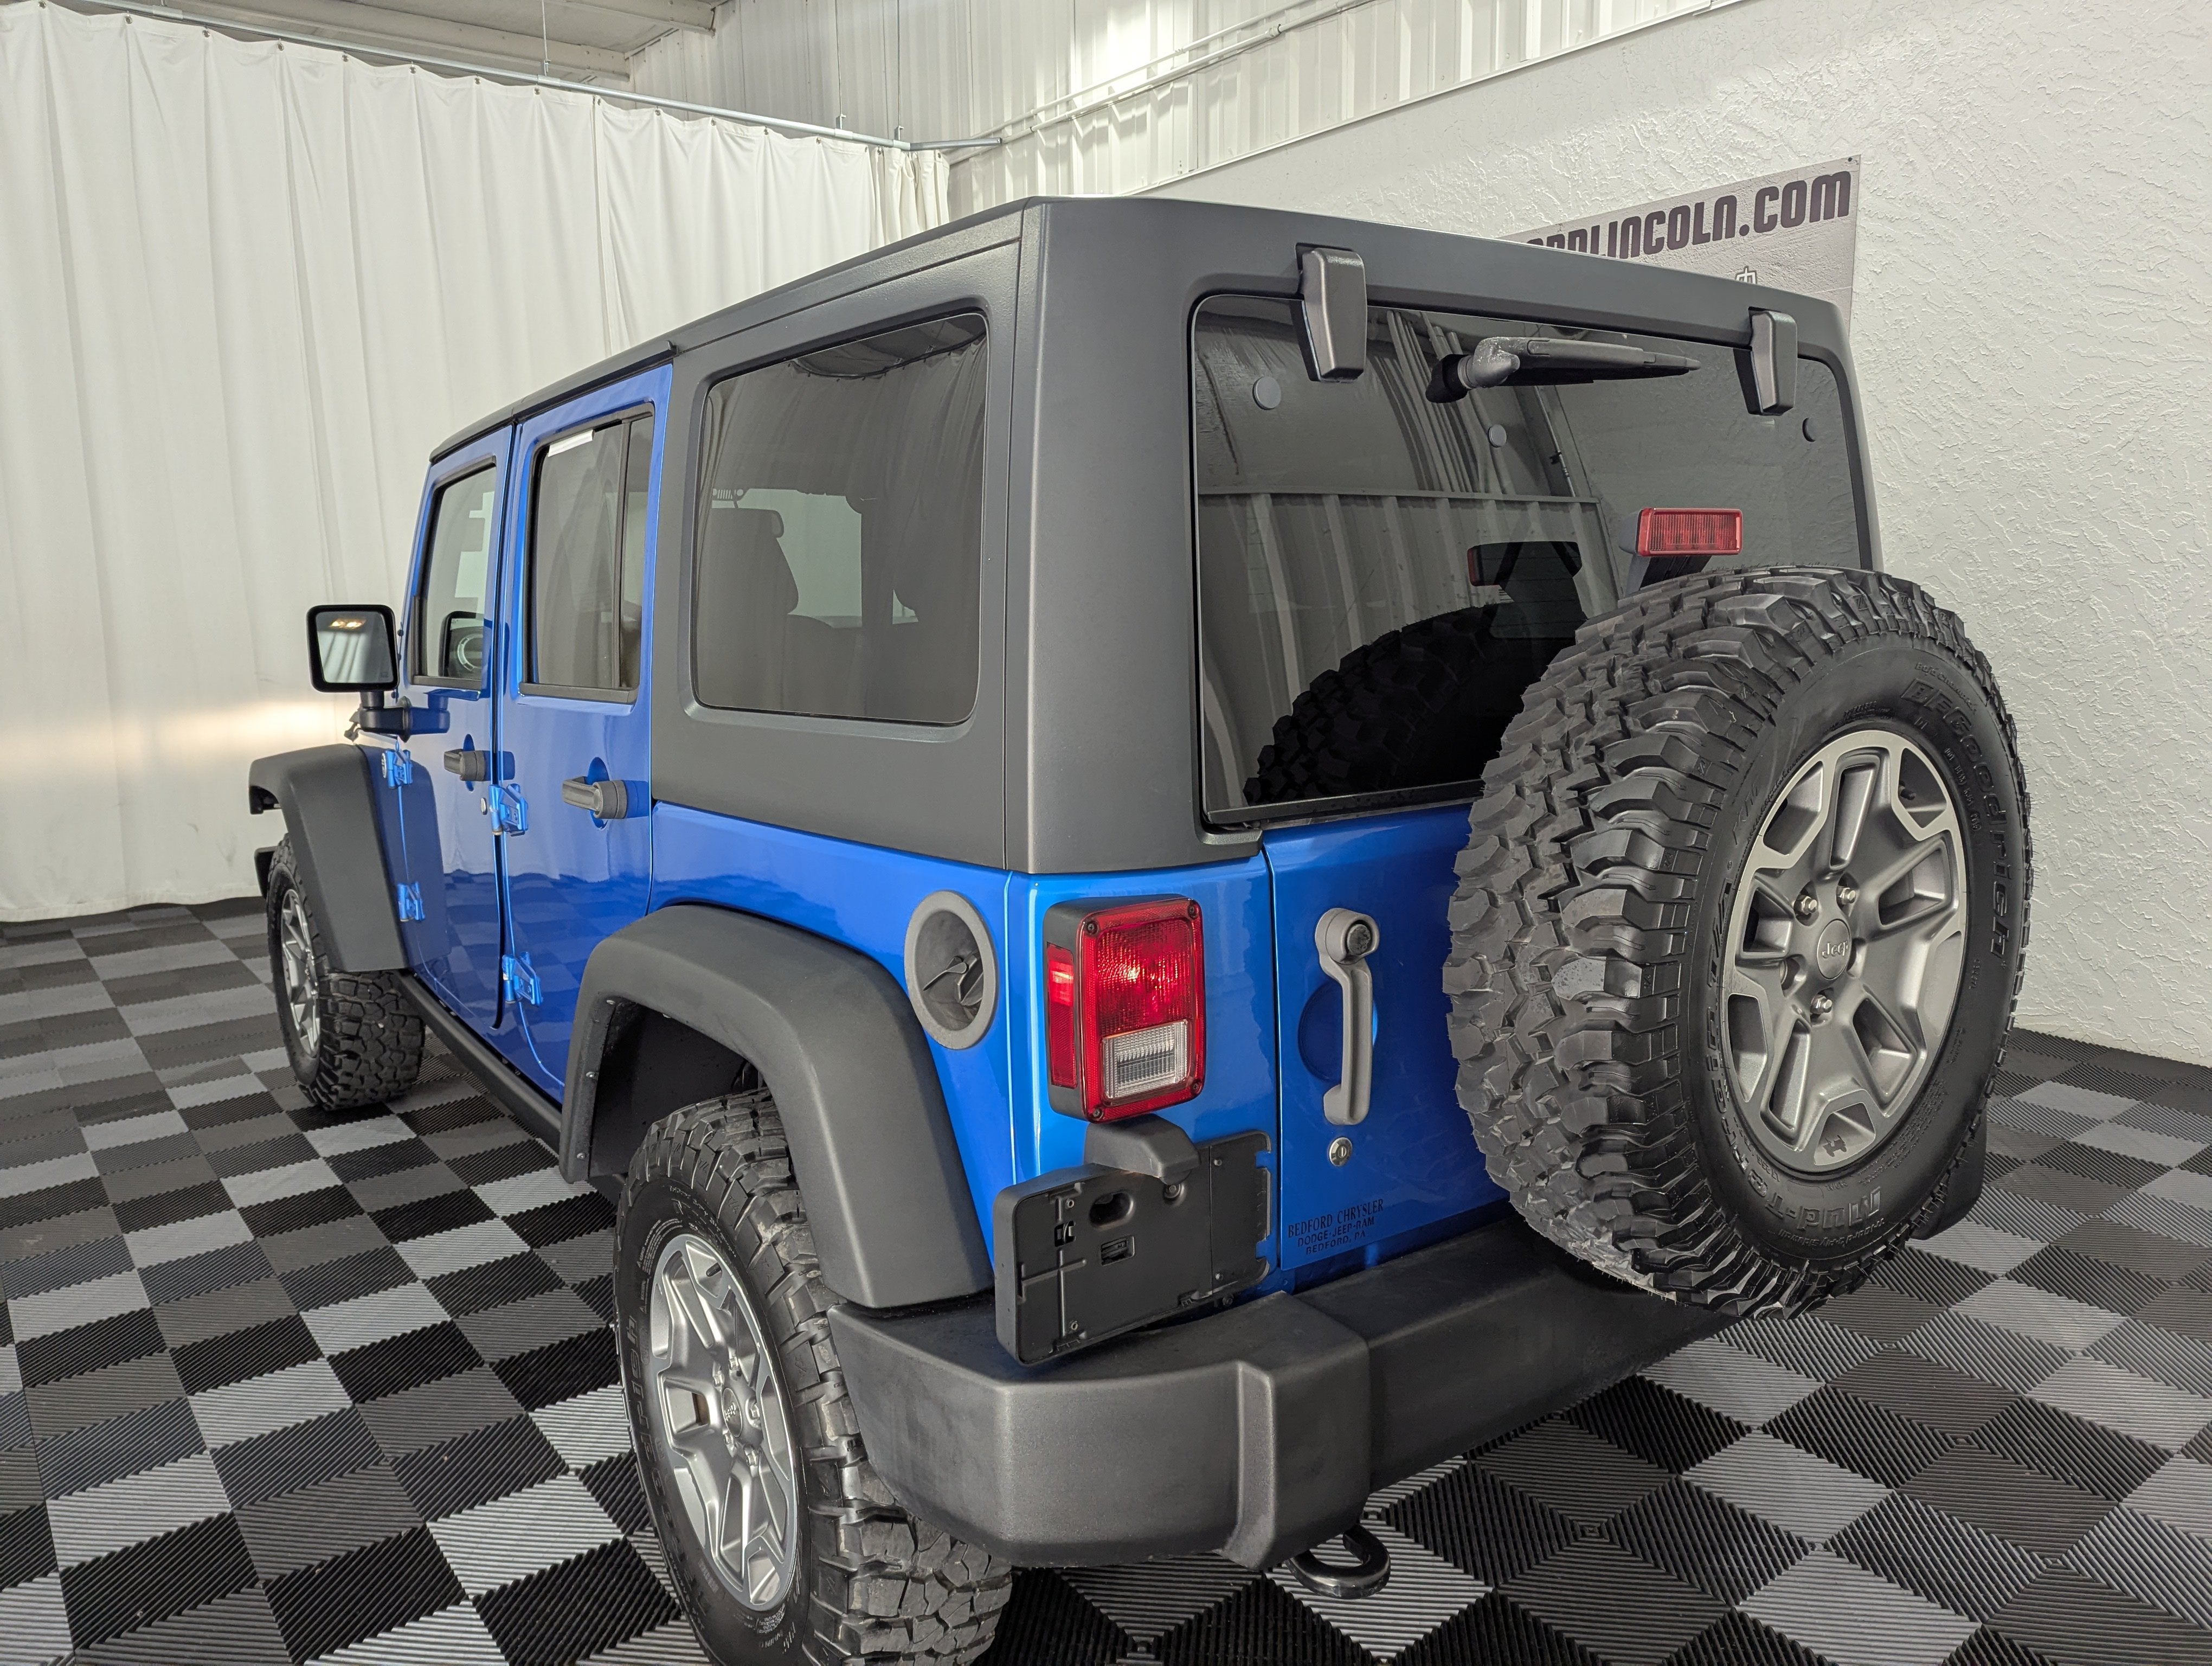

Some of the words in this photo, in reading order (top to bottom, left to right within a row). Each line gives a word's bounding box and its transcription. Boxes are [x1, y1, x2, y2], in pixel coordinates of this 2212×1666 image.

[1900, 678, 2012, 959] BFGoodrich
[1822, 941, 1848, 959] Jeep
[1288, 1214, 1333, 1238] BEDFORD
[1337, 1199, 1384, 1225] CHRYSLER
[1306, 1235, 1352, 1255] BEDFORD,
[1355, 1230, 1366, 1240] PA
